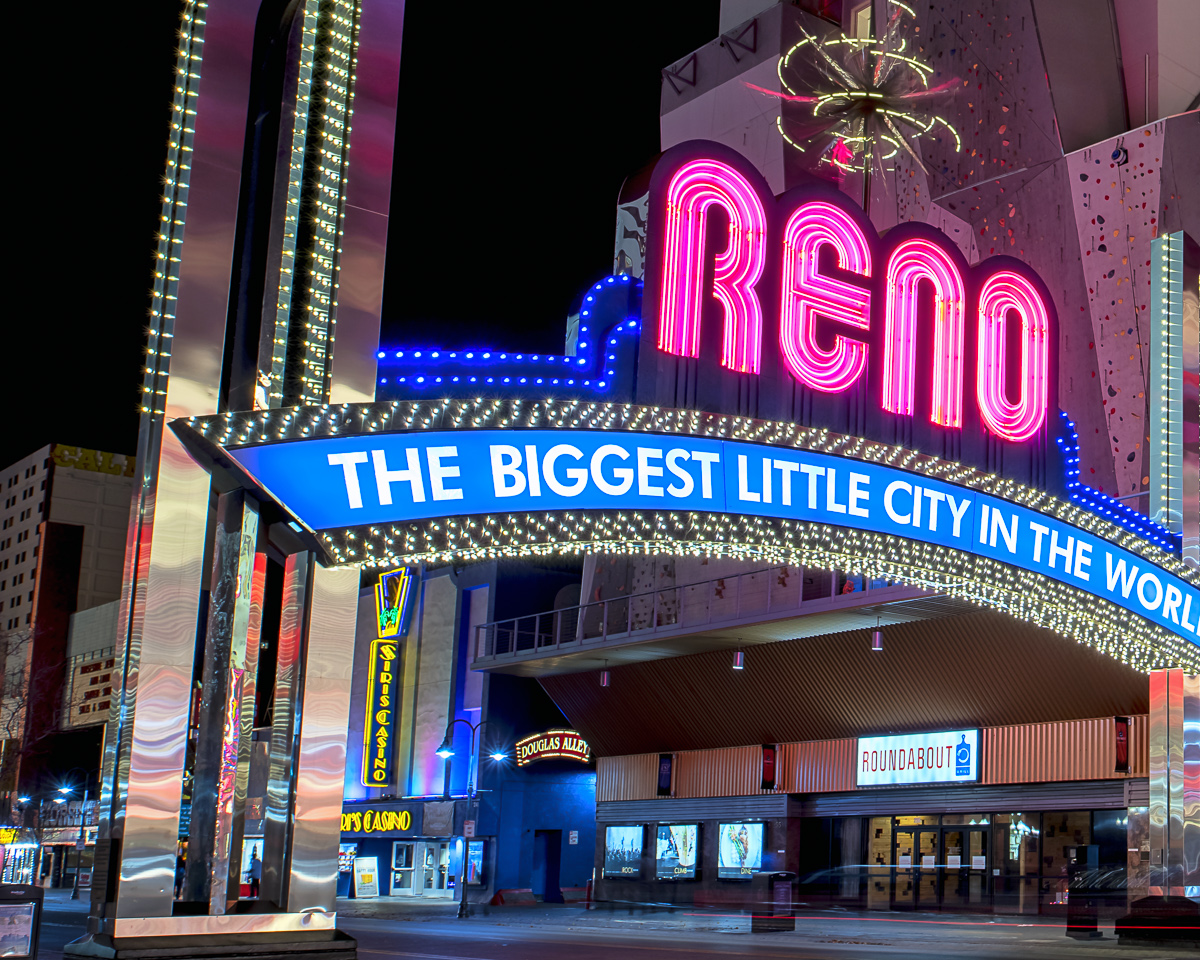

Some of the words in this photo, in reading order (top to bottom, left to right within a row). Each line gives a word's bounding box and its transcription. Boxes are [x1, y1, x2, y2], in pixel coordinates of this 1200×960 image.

[328, 444, 464, 510] THE
[489, 444, 721, 499] BIGGEST
[737, 454, 870, 518] LITTLE
[883, 480, 973, 538] CITY
[978, 503, 1020, 555] IN
[1030, 520, 1093, 581] THE
[373, 709, 392, 782] CASINO
[521, 736, 561, 759] DOUGLAS
[561, 737, 588, 755] ALLEY
[862, 745, 953, 773] ROUNDABOUT
[363, 809, 411, 834] CASINO
[673, 867, 688, 875] CLIMB
[740, 867, 752, 875] DINE
